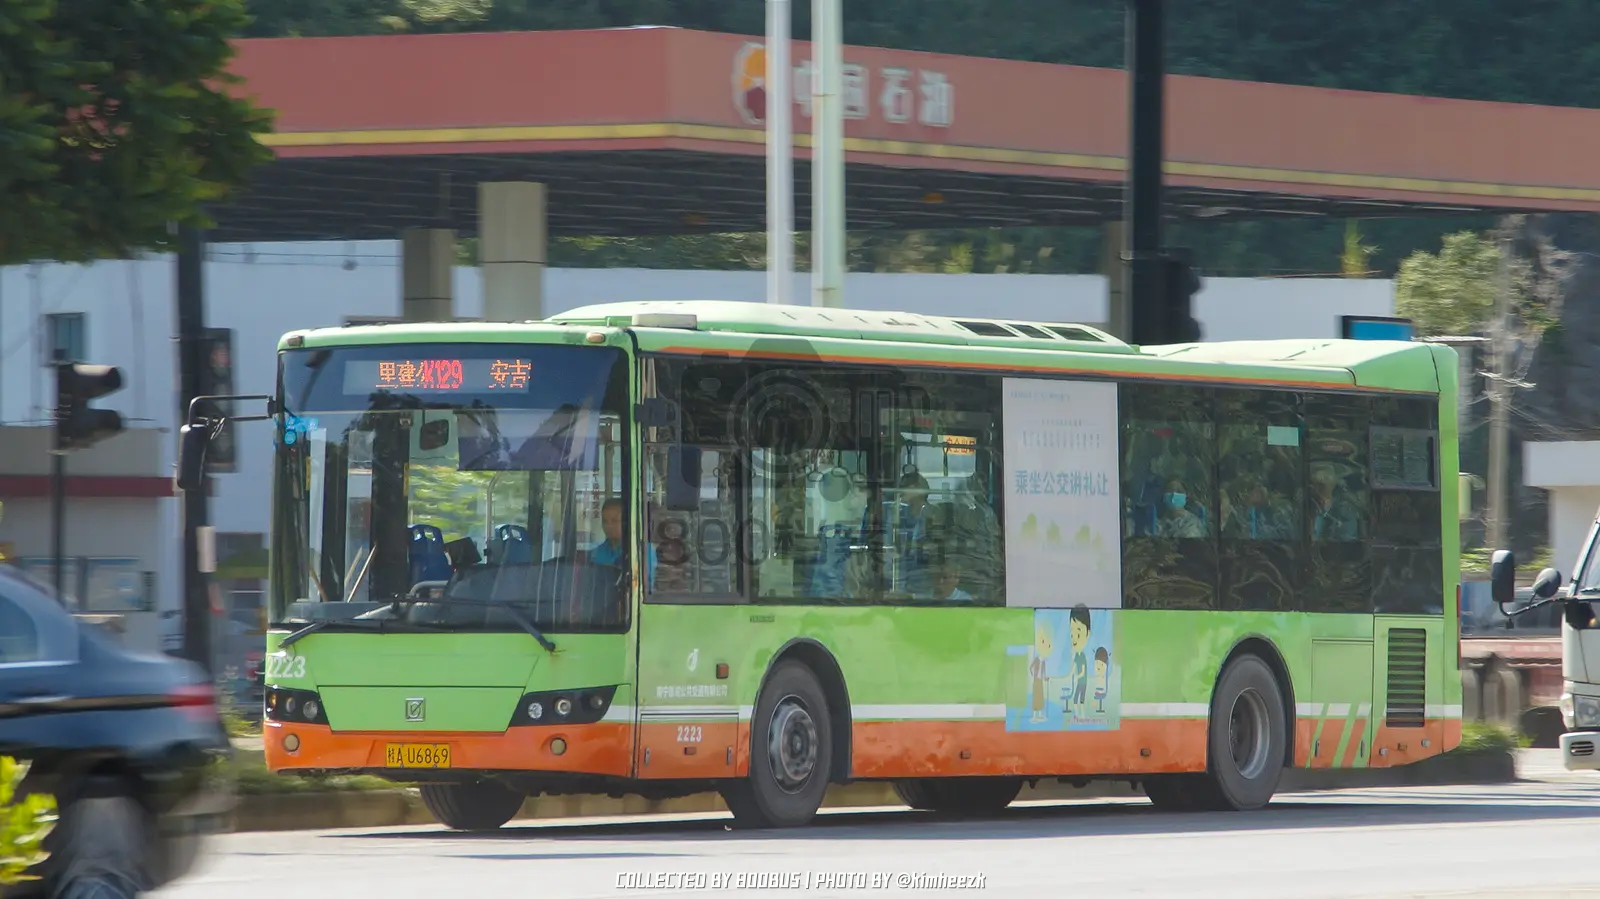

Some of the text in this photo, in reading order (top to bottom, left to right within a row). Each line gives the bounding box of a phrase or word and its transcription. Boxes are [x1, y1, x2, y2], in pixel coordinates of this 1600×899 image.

[422, 359, 465, 390] K129
[489, 359, 532, 389] 安吉
[1015, 470, 1109, 497] 乘坐公交讲礼让
[264, 655, 306, 678] 2223
[677, 726, 702, 742] 2223
